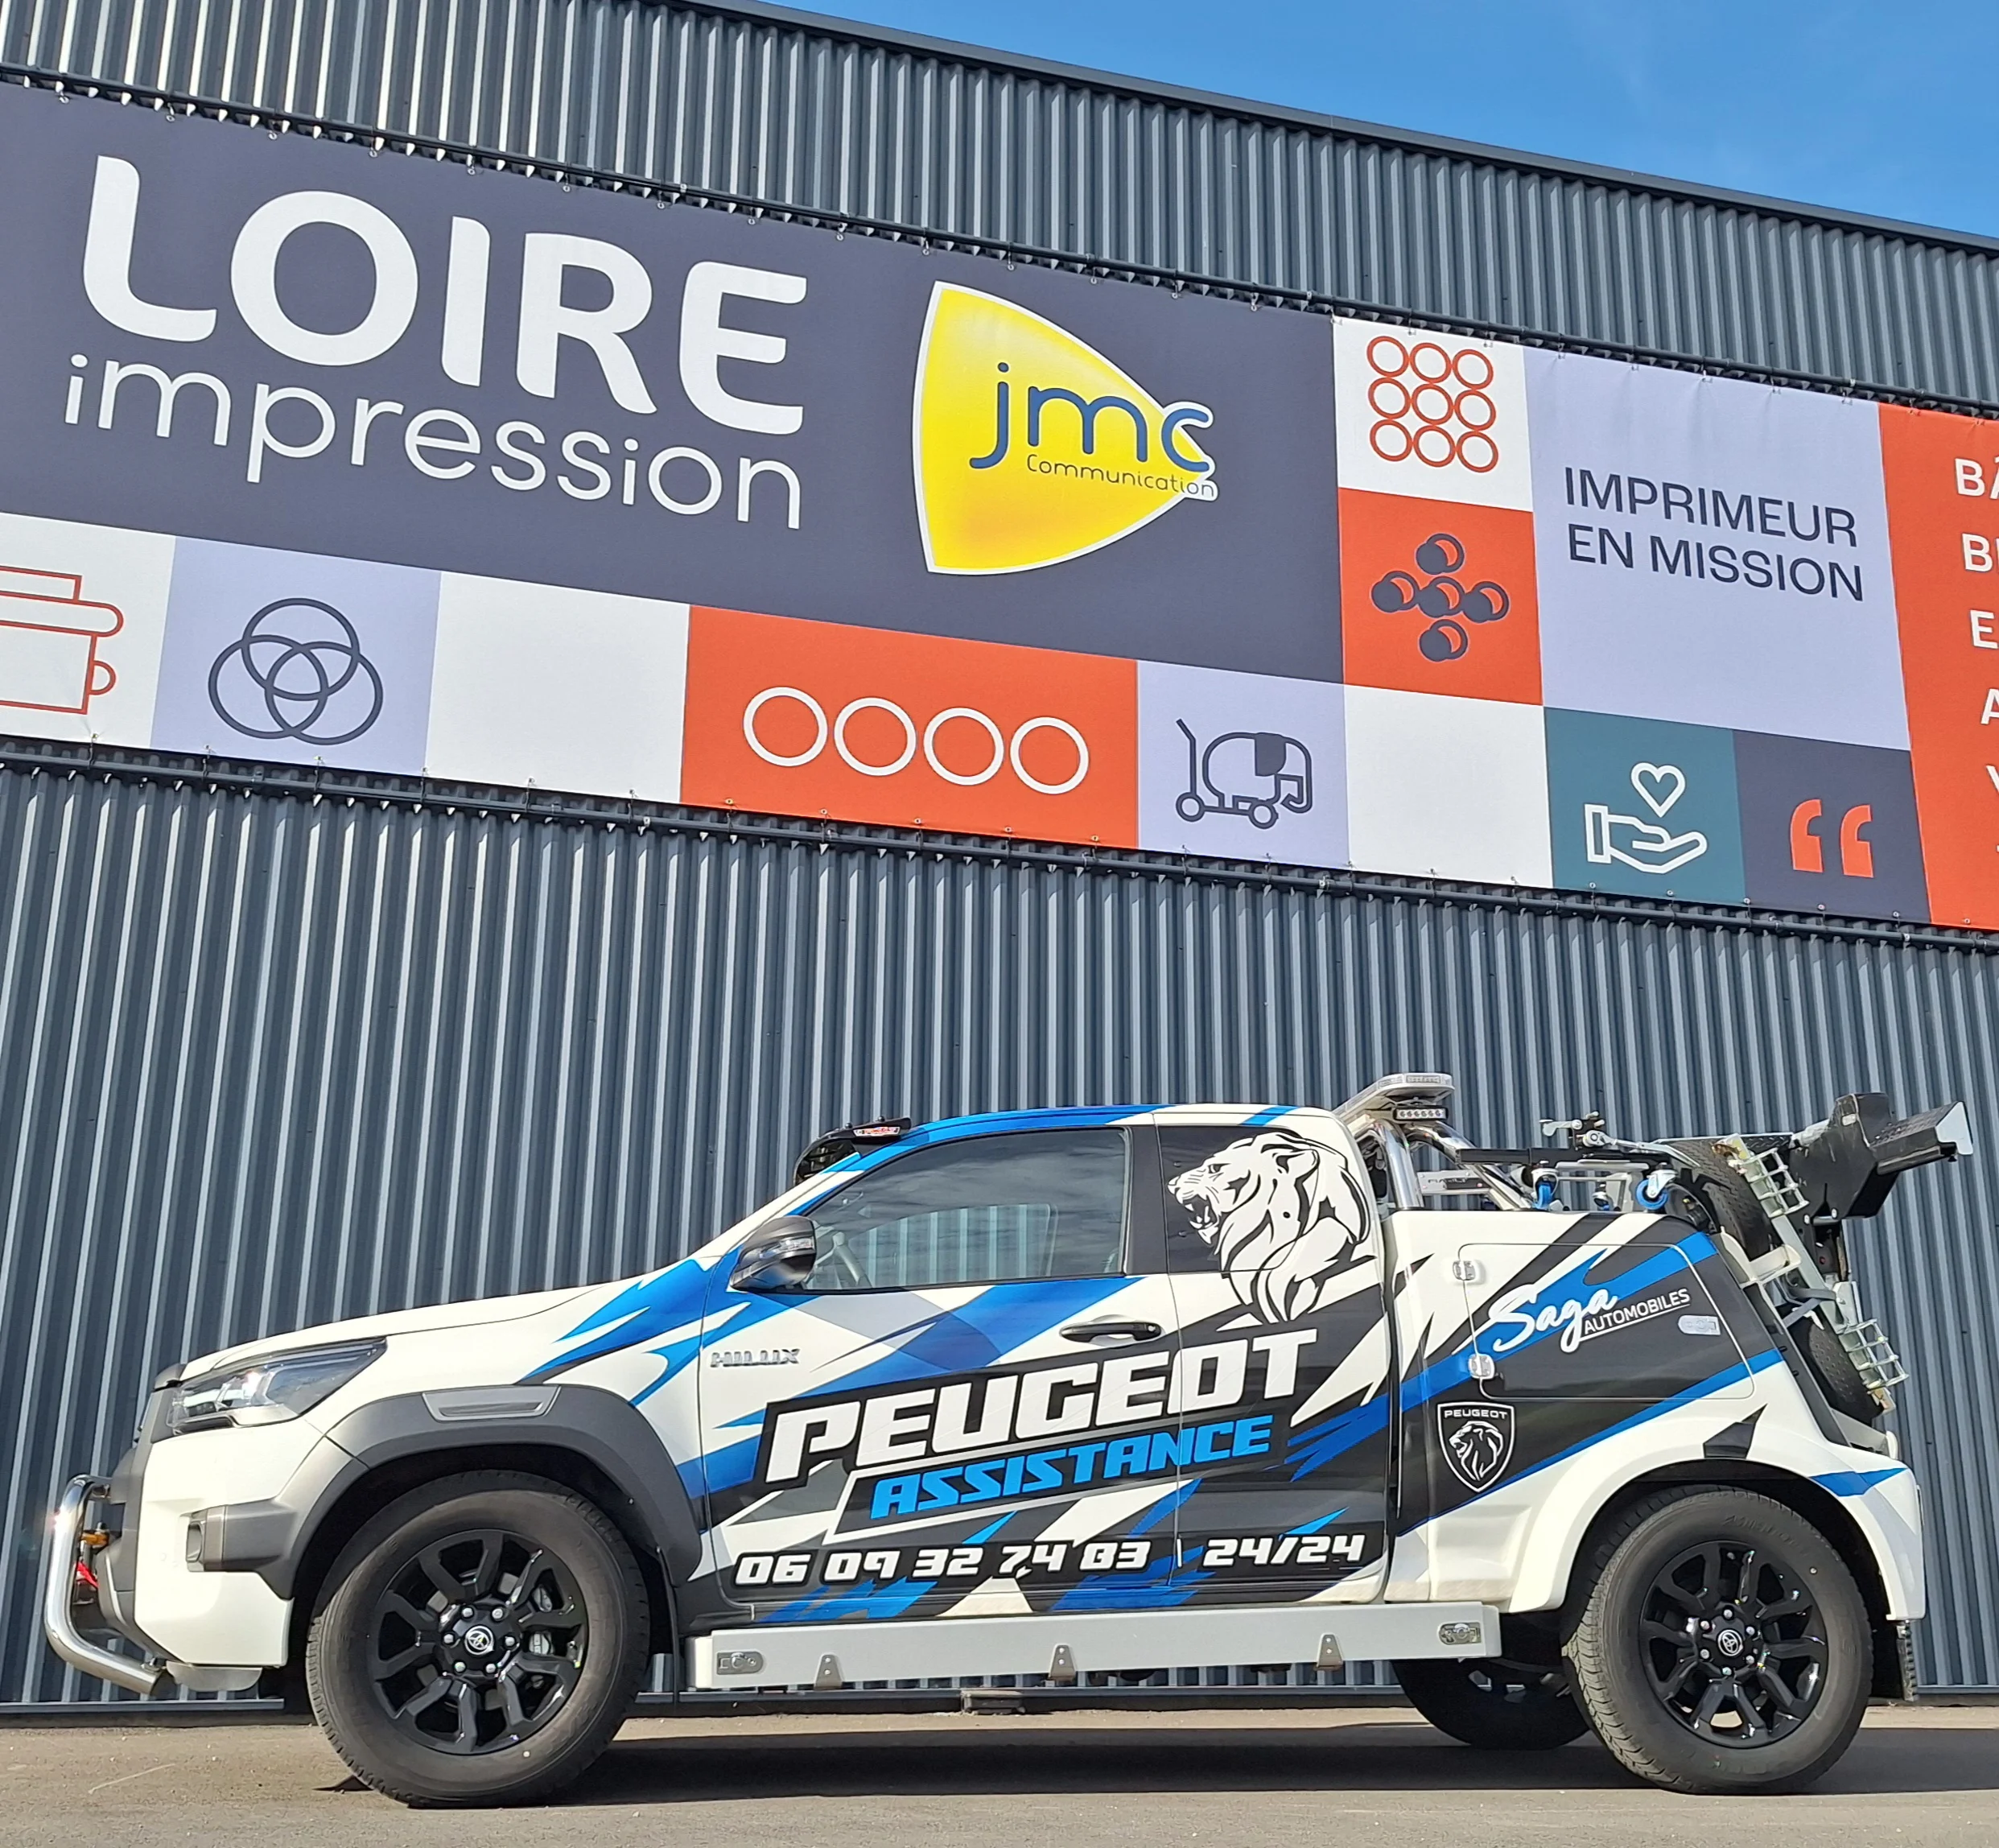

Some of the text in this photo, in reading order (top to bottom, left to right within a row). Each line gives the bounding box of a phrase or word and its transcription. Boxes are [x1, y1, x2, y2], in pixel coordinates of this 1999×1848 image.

[83, 155, 807, 435] LOIRE
[65, 353, 801, 530] impression
[970, 362, 1210, 472] jmc
[1027, 453, 1214, 497] Communication
[1564, 467, 1857, 547] IMPRIMEUR
[1568, 523, 1864, 602] EN MISSION
[1962, 533, 1999, 573] B
[1488, 1283, 1691, 1353] Saga AUTOMOBILES
[765, 1328, 1317, 1484] PEUGEOT
[1444, 1409, 1508, 1420] PEUGEOT
[869, 1414, 1275, 1520] ASSISTANCE
[736, 1534, 1366, 1585] 06 09 32 74 83 24/24
